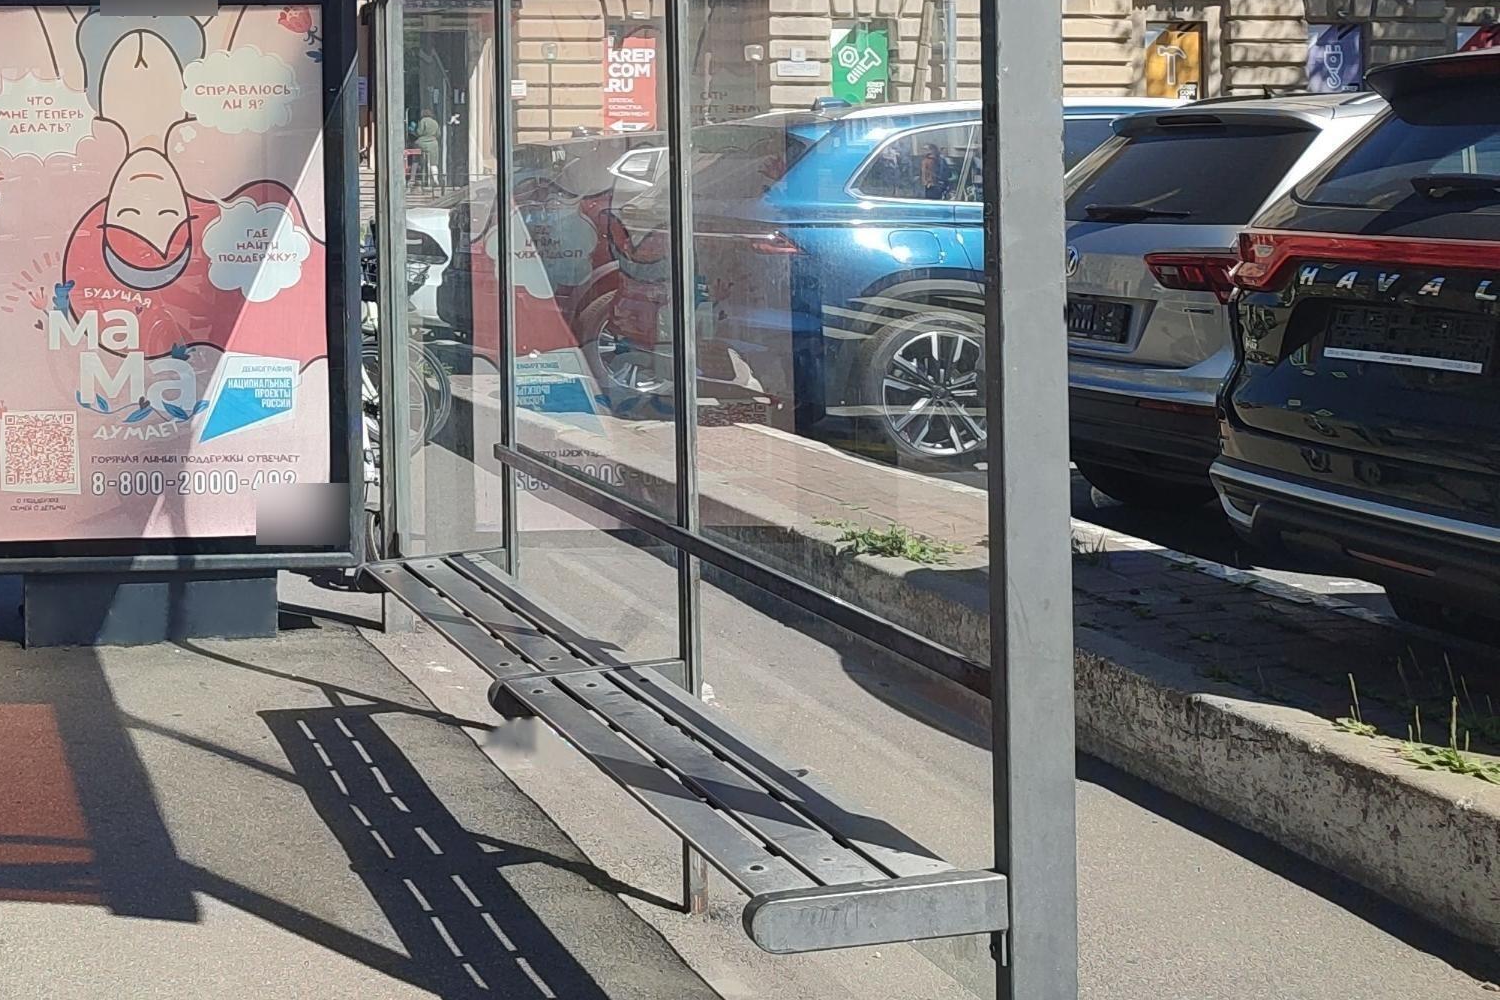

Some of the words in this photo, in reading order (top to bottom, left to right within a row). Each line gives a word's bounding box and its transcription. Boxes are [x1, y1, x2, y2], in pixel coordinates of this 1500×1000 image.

[608, 48, 655, 62] KREP
[608, 63, 650, 77] COM
[195, 84, 291, 95] СПРАВЛЮСЬ
[27, 96, 53, 105] ЧТО
[222, 99, 242, 109] ЛИ
[249, 99, 264, 109] Я?
[35, 109, 84, 119] ТЕПЕРЬ
[10, 122, 71, 134] ДЕЛАТЬ?
[246, 228, 268, 238] ГДЕ
[236, 239, 278, 250] НАЙТИ
[218, 253, 297, 263] ПОДДЕРЖКУ?
[1299, 265, 1499, 301] HAVAL
[83, 287, 152, 308] БУДУЩАЯ
[227, 378, 292, 389] НАЦИОНАЛЬНЫЕ
[254, 389, 291, 398] ПРОЕКТЫ
[261, 398, 291, 408] РОССИИ
[93, 420, 180, 441] ДУМАЕТ
[91, 455, 139, 464] ГОРЯЧАЯ
[142, 455, 177, 464] ЛИНИЯ
[181, 454, 243, 464] ПОДДЕРЖКИ
[247, 454, 300, 463] ОТВЕЧАЕТ
